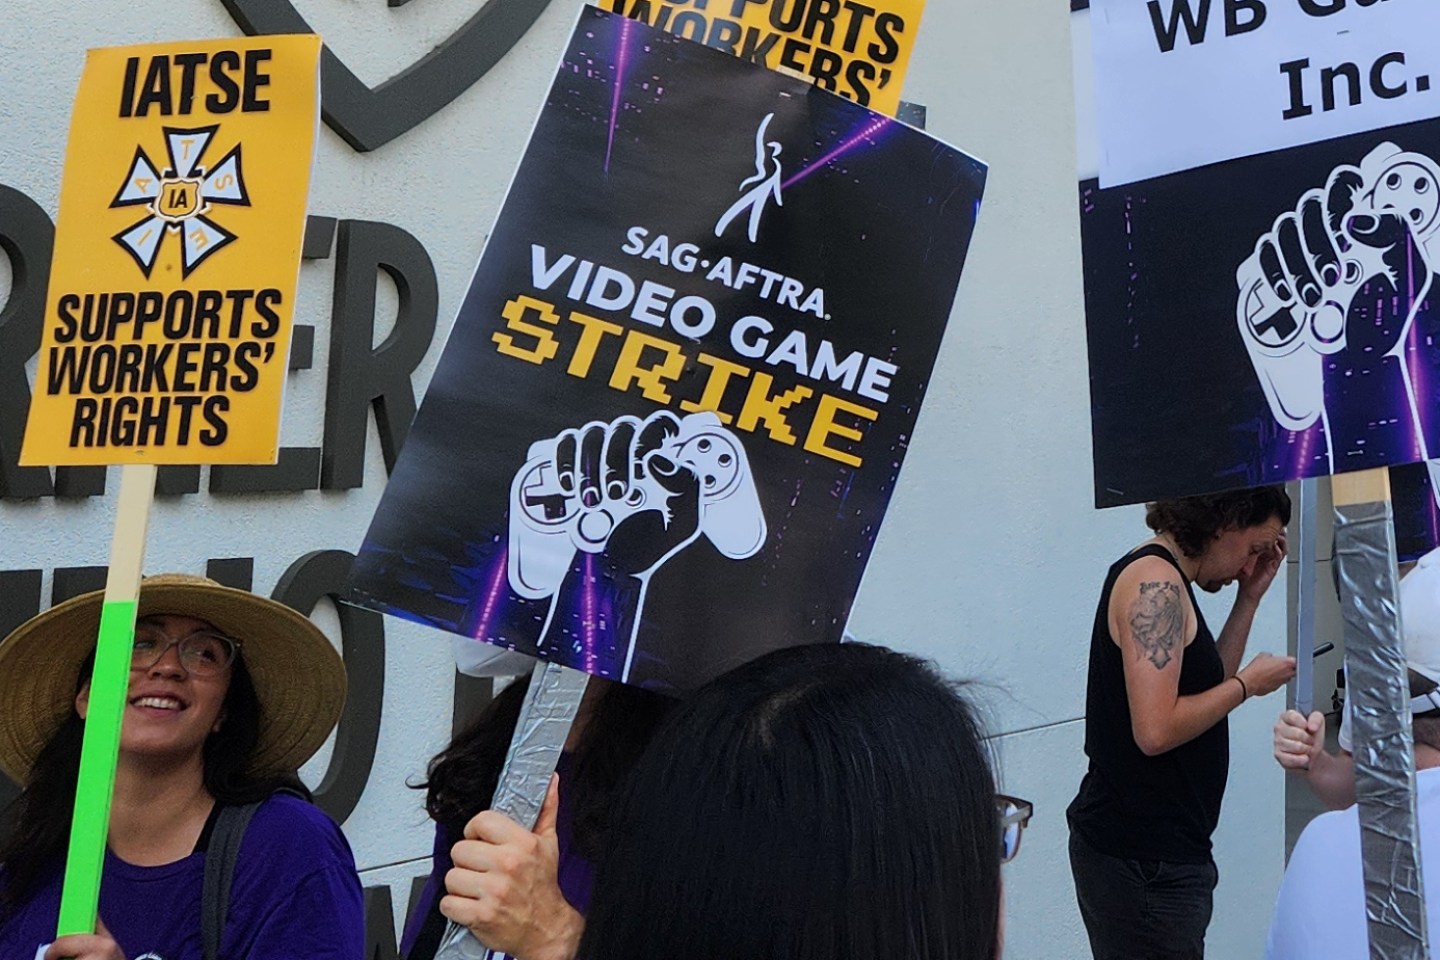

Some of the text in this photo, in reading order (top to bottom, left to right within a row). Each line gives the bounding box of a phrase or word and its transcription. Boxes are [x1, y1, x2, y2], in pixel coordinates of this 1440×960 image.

[119, 48, 272, 118] IATSE
[1280, 51, 1432, 121] Inc.
[54, 288, 283, 343] SUPPORTS
[531, 243, 897, 403] VIDEO GAME
[47, 341, 276, 396] WORKERS'
[491, 293, 878, 468] STRIKE
[69, 395, 230, 448] RIGHTS
